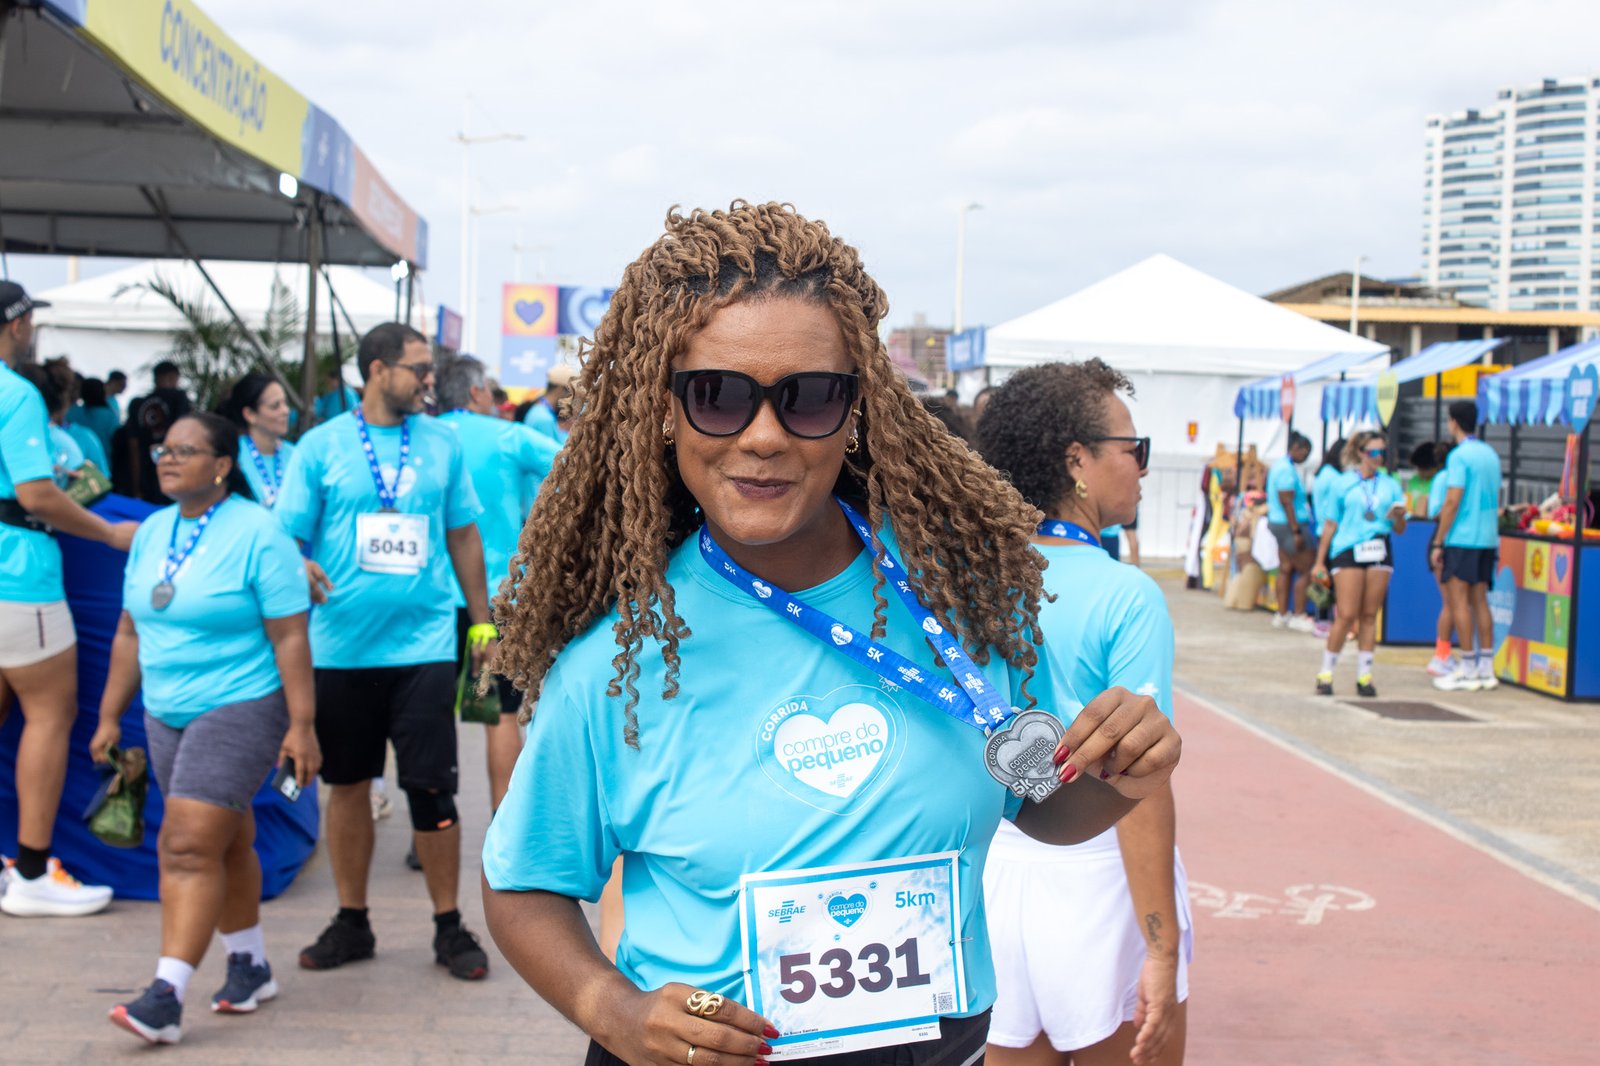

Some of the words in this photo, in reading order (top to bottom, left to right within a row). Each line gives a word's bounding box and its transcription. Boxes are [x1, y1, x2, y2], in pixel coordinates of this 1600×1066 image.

[160, 0, 267, 136] CONCENTRAÇÃO
[369, 539, 418, 556] 5043
[897, 580, 912, 593] 5K
[786, 602, 802, 617] 5K
[866, 647, 885, 663] 5K
[944, 646, 961, 662] 5K
[897, 666, 925, 684] SEBRAE
[965, 672, 985, 695] SEBRAE
[938, 687, 957, 703] 5K
[761, 700, 809, 742] CORRIDA
[989, 706, 1005, 724] 5K
[782, 731, 852, 757] compre
[856, 722, 880, 740] do
[787, 739, 884, 776] pequeno
[989, 735, 1007, 766] CORRIDA
[1009, 745, 1037, 769] compre
[1035, 738, 1046, 749] do
[1015, 741, 1056, 777] pequeno
[1011, 778, 1034, 795] 5k
[1029, 780, 1056, 801] 10k
[830, 902, 855, 912] compre
[895, 890, 936, 909] 5km
[768, 905, 807, 918] SEBRAE
[830, 907, 865, 918] pequeno
[779, 937, 931, 1004] 5331
